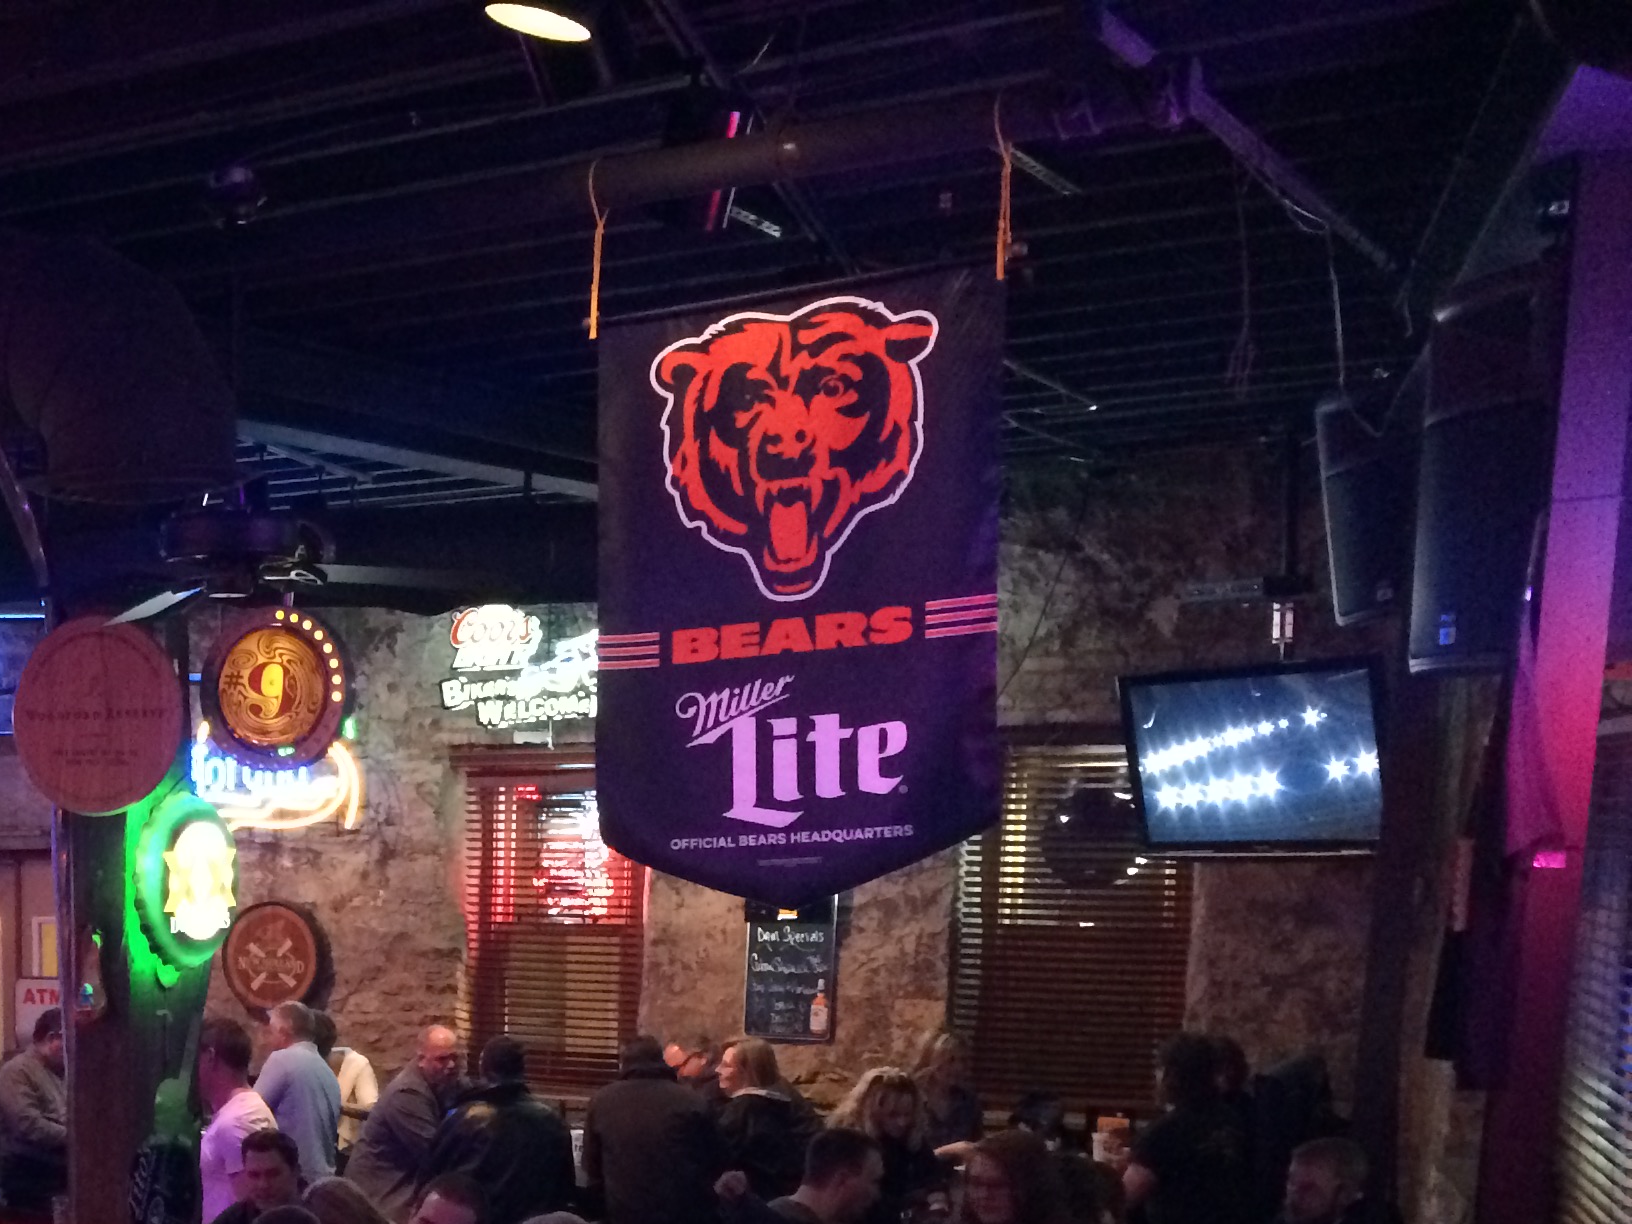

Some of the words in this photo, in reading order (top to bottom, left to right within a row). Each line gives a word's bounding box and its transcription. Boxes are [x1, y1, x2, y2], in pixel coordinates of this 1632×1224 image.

[672, 605, 913, 664] BEARS
[675, 674, 795, 737] Miller
[686, 713, 908, 829] Lite
[670, 836, 735, 850] OFFICIAL
[739, 832, 787, 846] BEARS
[790, 824, 914, 843] HEADQUARTERS
